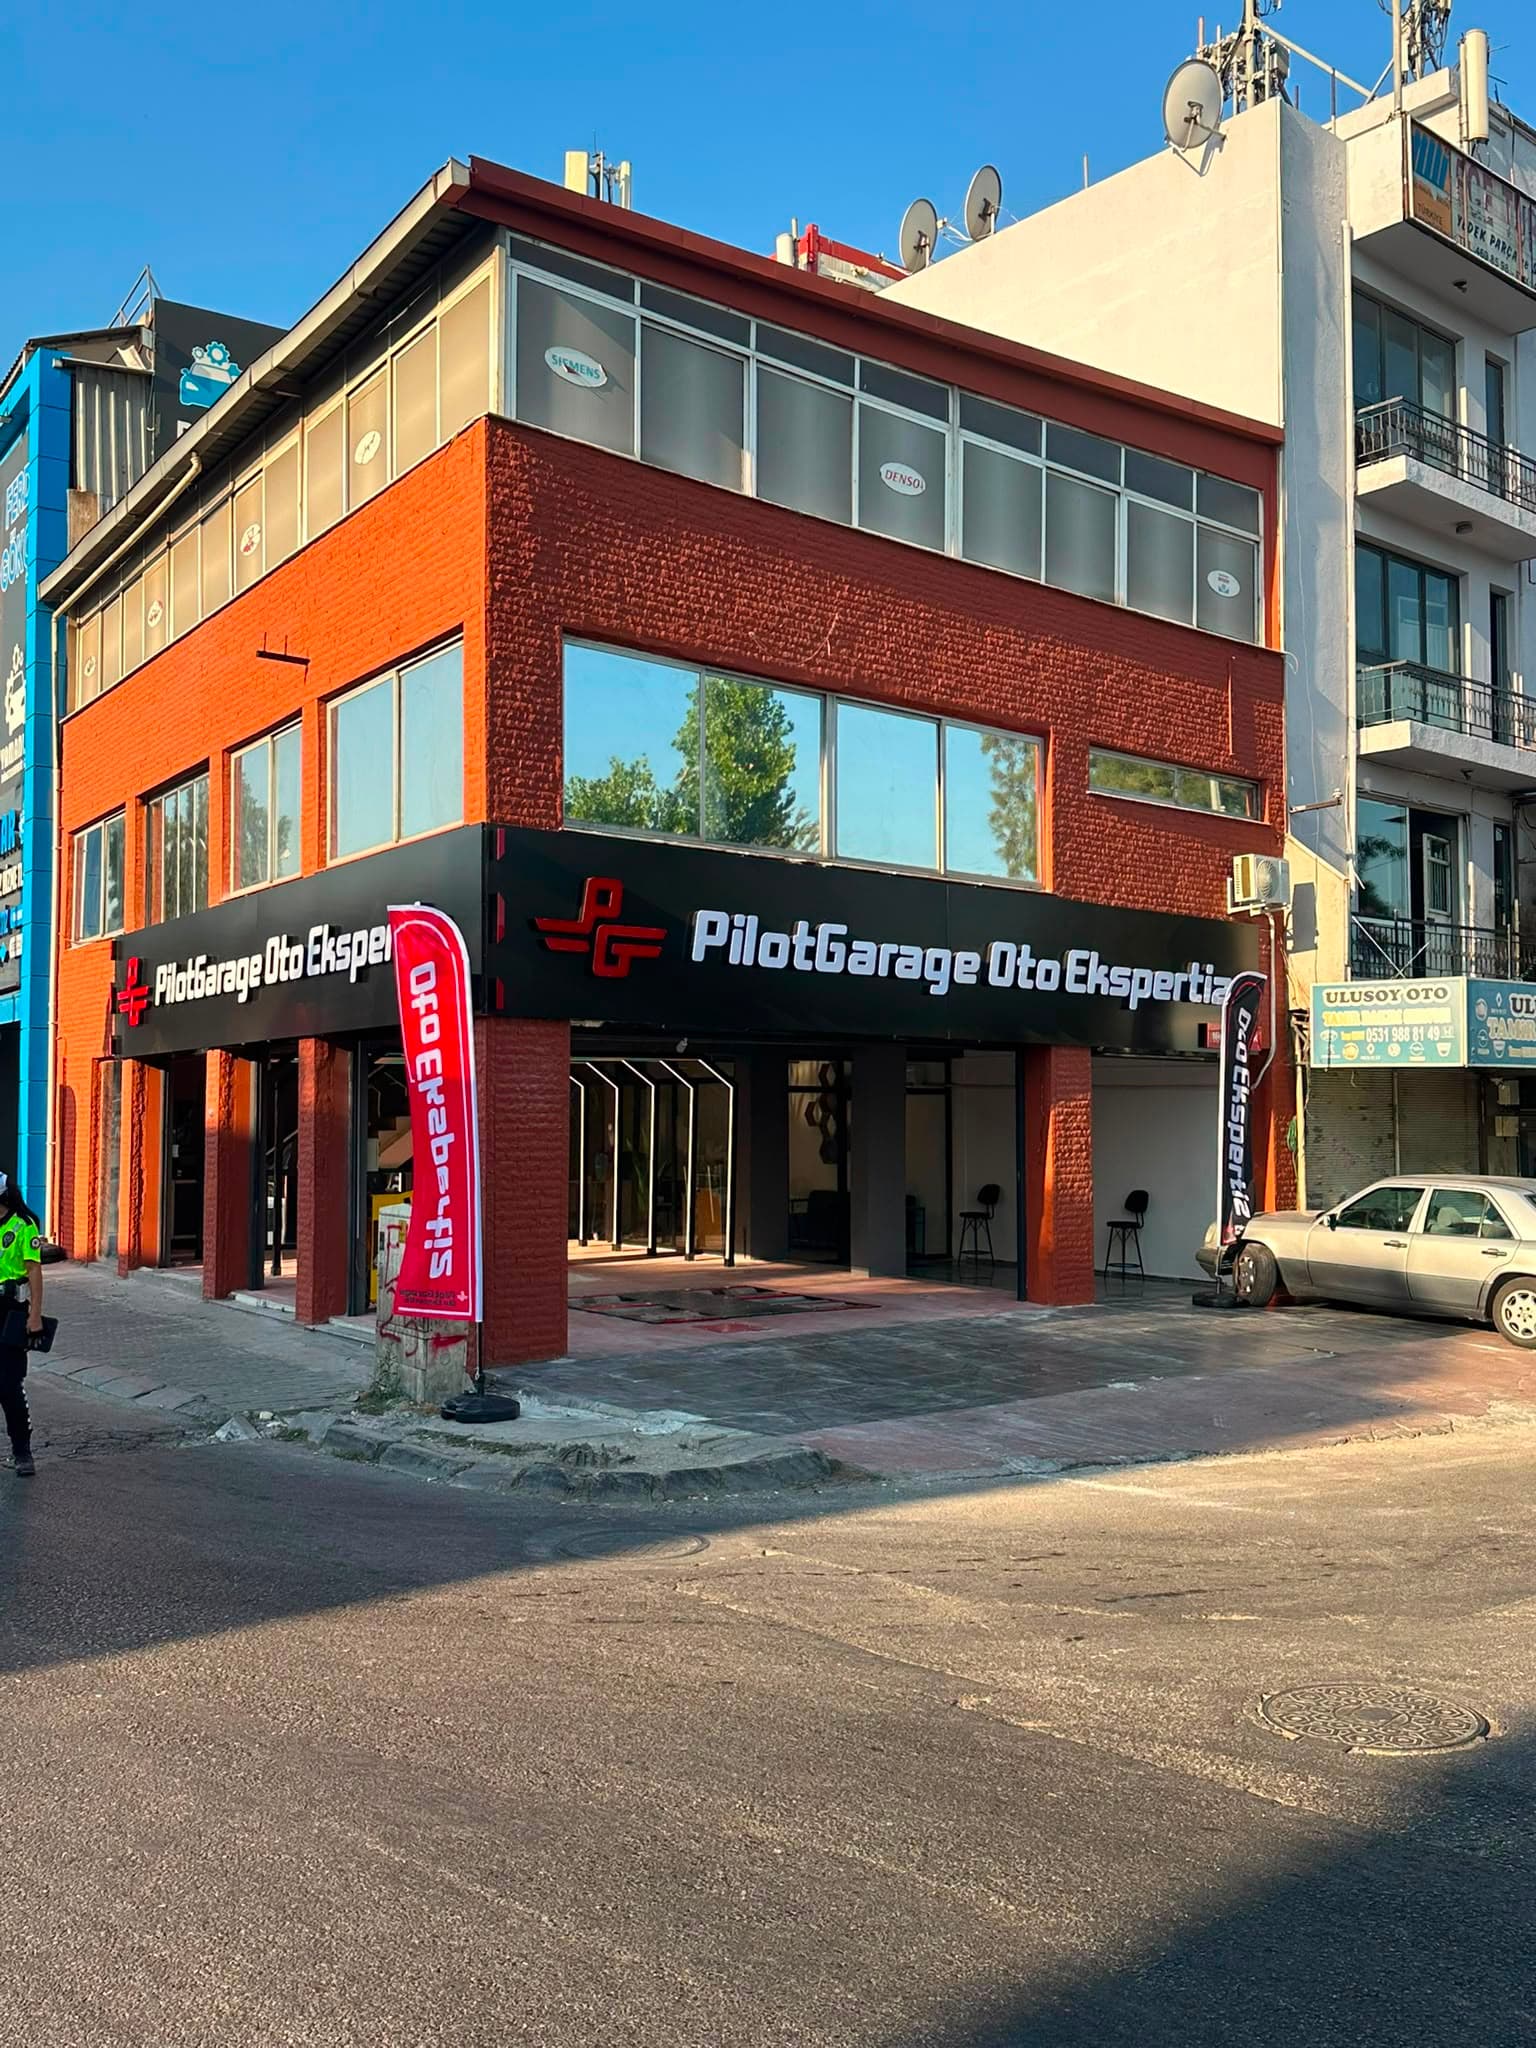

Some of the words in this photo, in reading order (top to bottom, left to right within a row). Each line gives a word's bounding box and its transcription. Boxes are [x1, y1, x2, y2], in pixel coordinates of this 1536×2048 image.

[885, 469, 921, 489] DENSO
[155, 954, 263, 1006] PilotGarage
[264, 934, 304, 985] Oto
[692, 910, 981, 996] PilotGarage
[988, 941, 1061, 992] Oto
[1325, 988, 1401, 1004] ULUSOY
[1406, 987, 1448, 1000] OTO
[1366, 1026, 1389, 1043] 0531
[1412, 1025, 1424, 1042] 81
[1228, 1064, 1251, 1219] Ekspertiz
